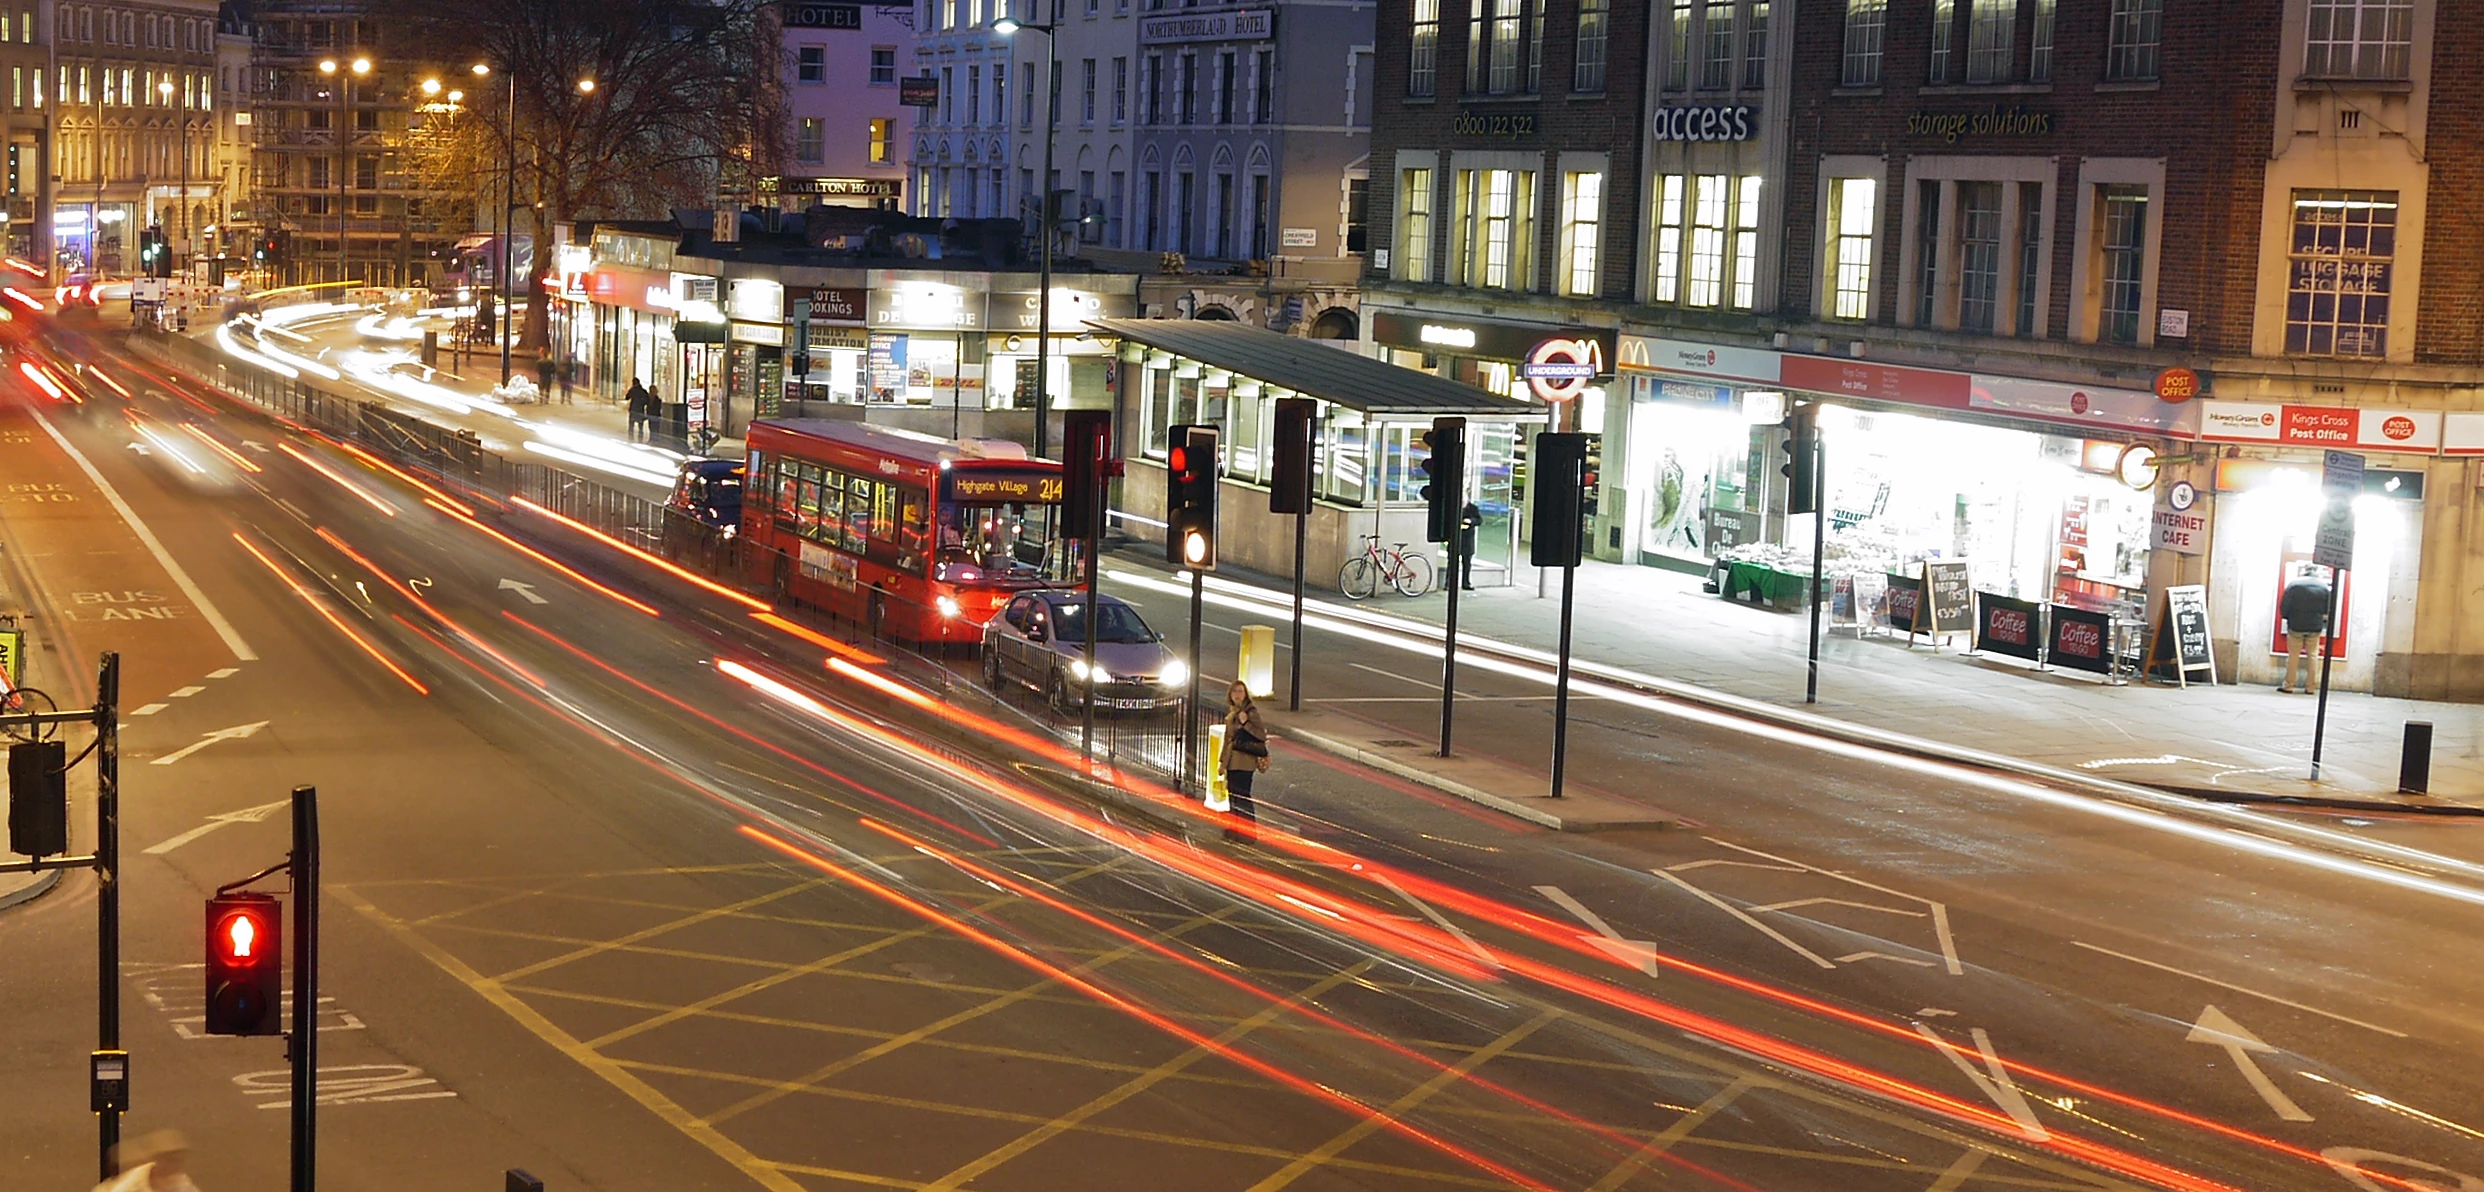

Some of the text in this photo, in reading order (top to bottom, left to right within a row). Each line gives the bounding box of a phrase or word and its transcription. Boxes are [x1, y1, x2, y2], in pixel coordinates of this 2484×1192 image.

[785, 8, 858, 26] HOTEL
[1146, 15, 1266, 38] NORTHUMBERLAND HOTEL
[1453, 110, 1533, 140] 0800 122 522
[1653, 106, 1749, 141] access
[1906, 104, 2049, 144] storage solutions
[788, 181, 893, 194] CARLTON HOTEL
[2301, 261, 2384, 278] LUGGAGE
[1527, 365, 1593, 378] UNDERGROUND
[2165, 376, 2190, 387] POST
[2161, 386, 2193, 397] OFFICE
[2291, 412, 2349, 427] Kings Cross
[2388, 420, 2411, 429] POST
[2289, 428, 2349, 442] Post Office
[956, 479, 1063, 500] Highgate Village 214
[1713, 512, 1741, 530] Bureau
[2152, 510, 2205, 531] INTERNET
[2162, 530, 2190, 546] CAFE
[2322, 535, 2347, 548] ZONE
[71, 590, 168, 604] BUS
[1991, 610, 2027, 633] Coffee
[2061, 622, 2099, 645] Coffee
